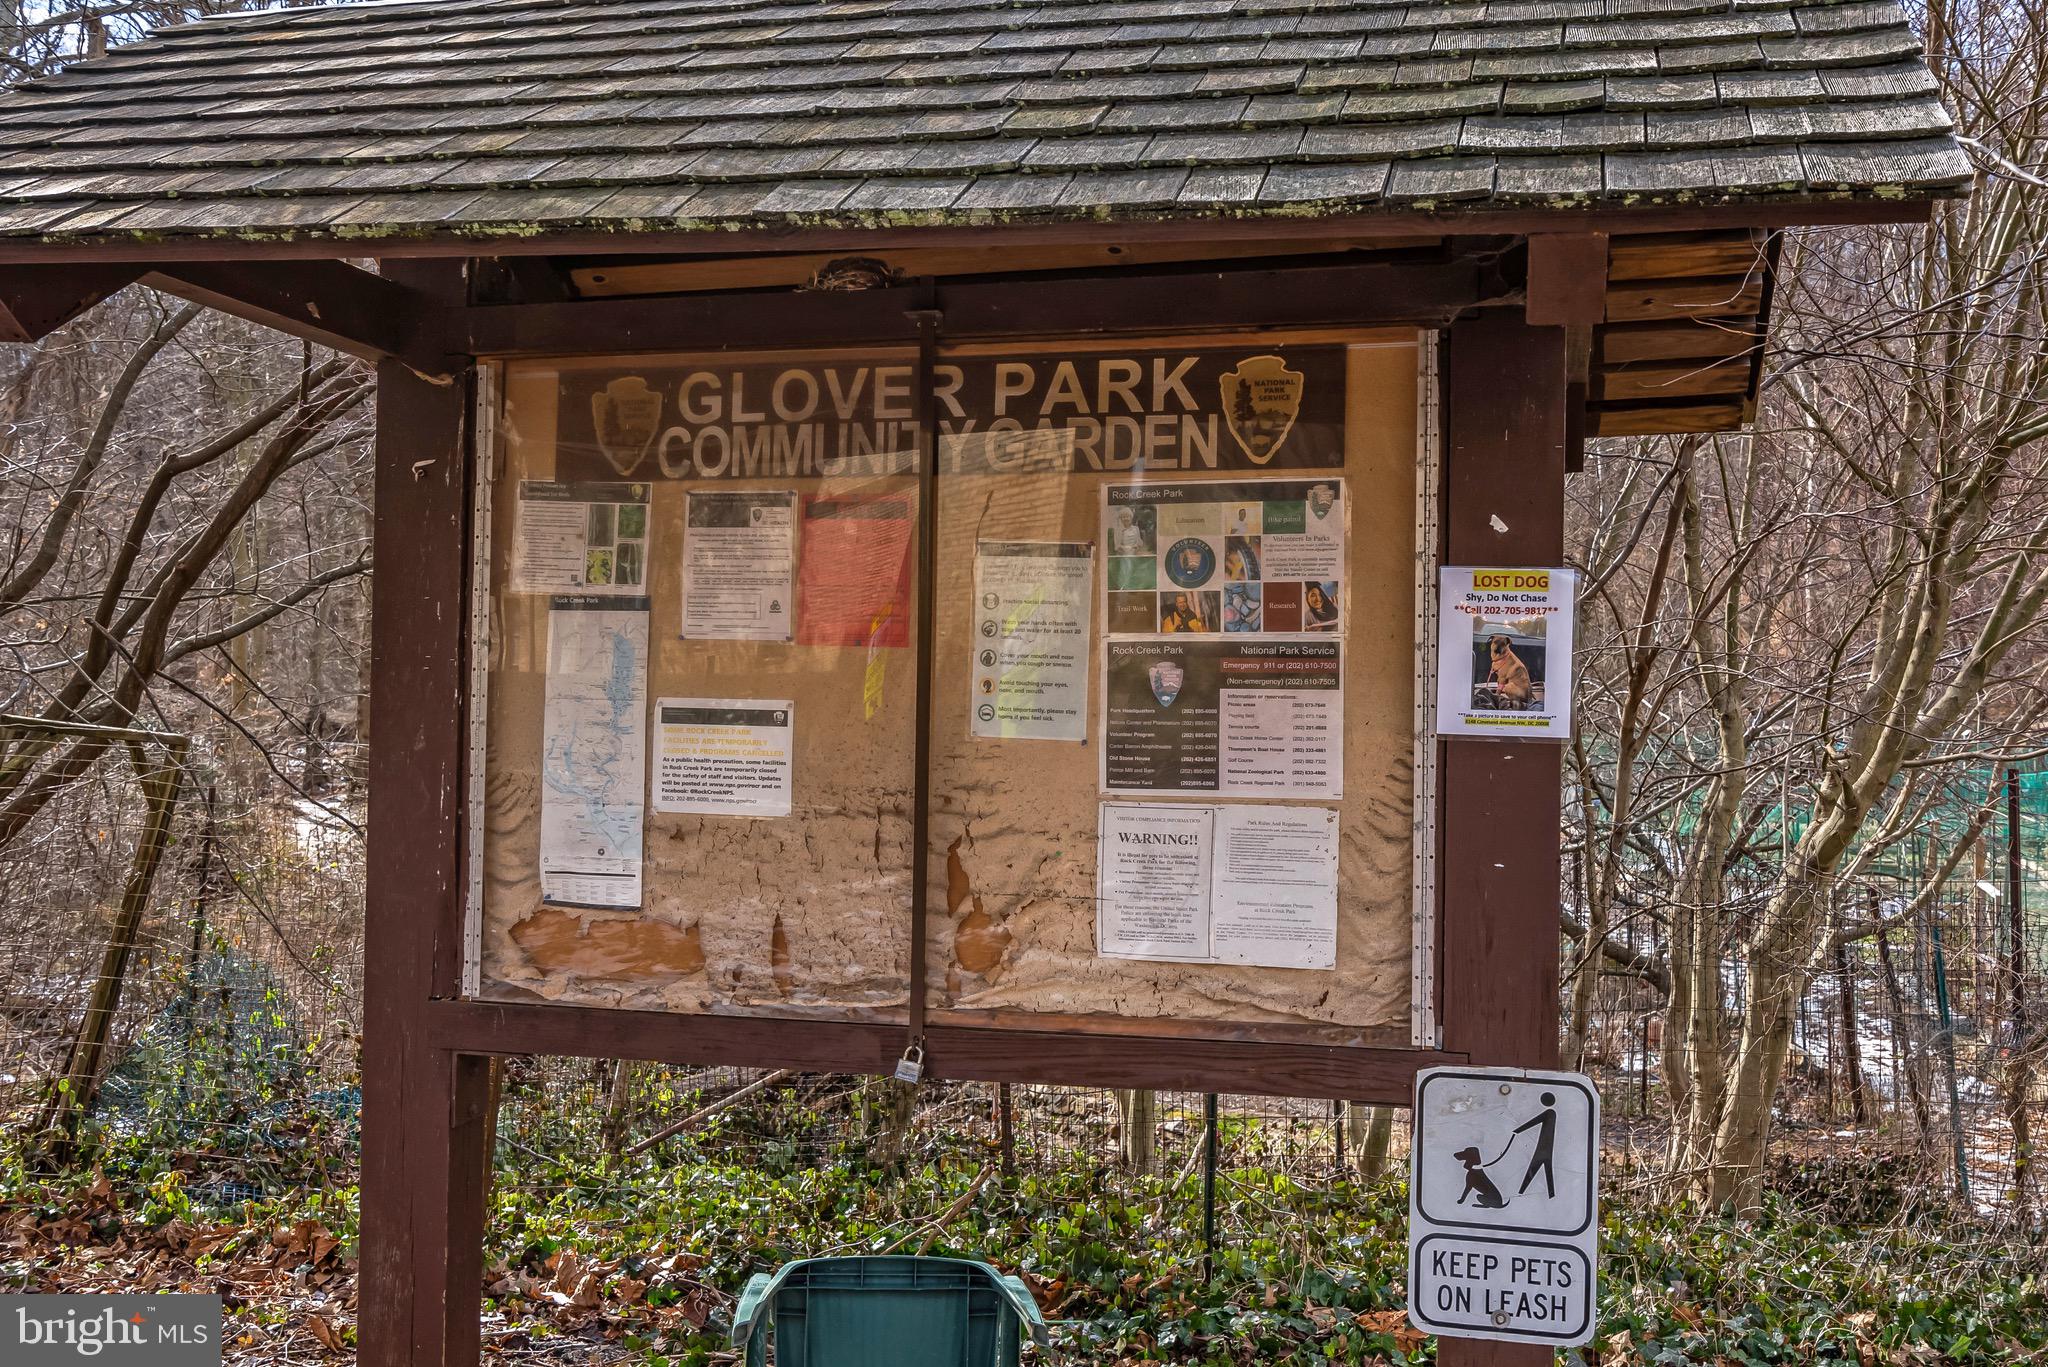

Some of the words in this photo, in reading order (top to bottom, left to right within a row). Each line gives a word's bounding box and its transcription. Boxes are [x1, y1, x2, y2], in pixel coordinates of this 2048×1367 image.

[678, 365, 966, 424] GLOVER
[994, 357, 1200, 416] PARK
[658, 419, 977, 479] COMMUNITY
[985, 414, 1218, 472] GARDEN
[1112, 491, 1134, 500] Rock
[1136, 490, 1160, 499] Creek
[1163, 489, 1184, 498] Park
[1474, 575, 1510, 588] LOST
[1514, 576, 1548, 588] DOG
[1466, 594, 1484, 602] Shy,
[1486, 594, 1500, 602] Do
[1502, 594, 1518, 602] Not
[1520, 594, 1548, 602] Chase
[1112, 646, 1134, 654] Rock
[1136, 646, 1162, 654] Creek
[1164, 646, 1184, 654] Park
[1240, 646, 1276, 654] National
[1280, 646, 1300, 654] Park
[1302, 646, 1334, 655] Service
[1224, 662, 1260, 670] Emergency
[1286, 662, 1304, 670] (202)
[1226, 678, 1284, 686] (Non-emergency)
[1285, 678, 1303, 686] (202)
[1118, 832, 1198, 846] WARNING!!
[1433, 1250, 1498, 1280] KEEP
[1512, 1257, 1572, 1288] PETS
[1437, 1284, 1471, 1313] ON
[1486, 1288, 1567, 1322] LEASH
